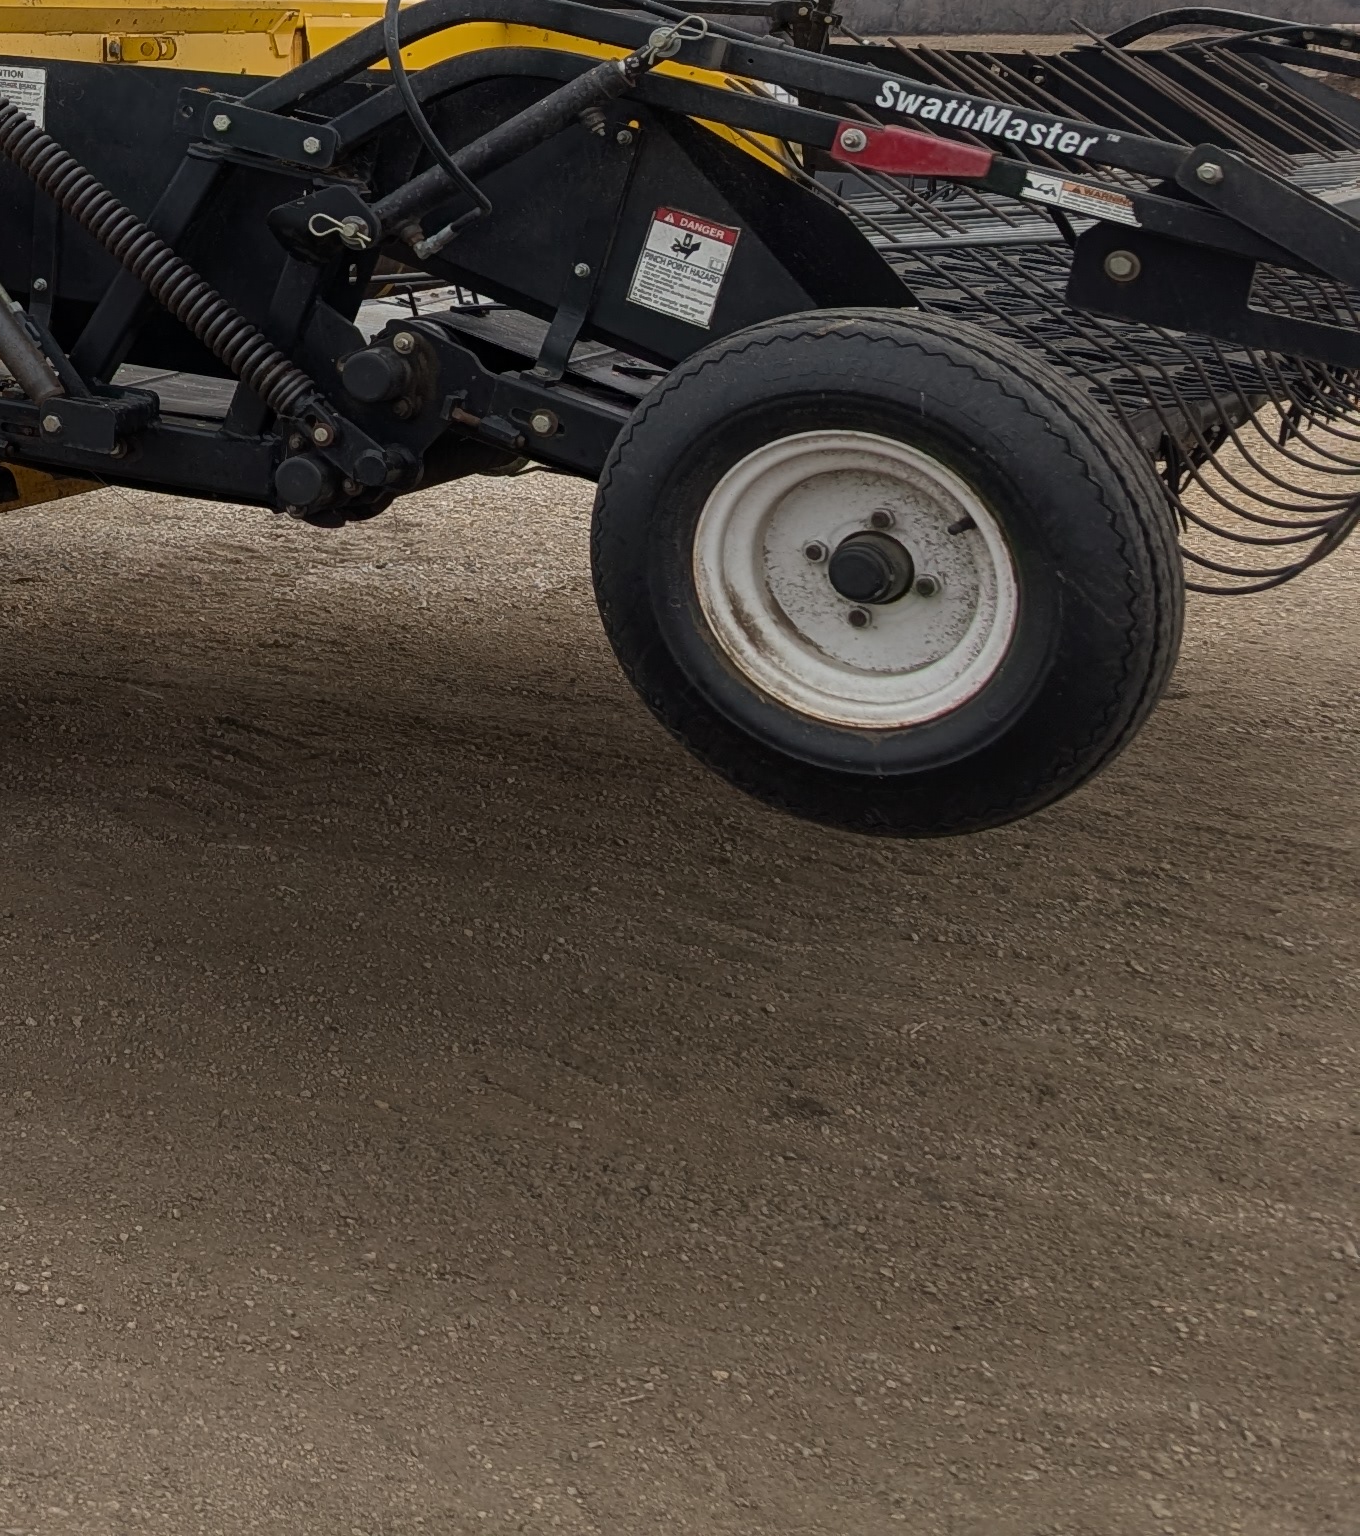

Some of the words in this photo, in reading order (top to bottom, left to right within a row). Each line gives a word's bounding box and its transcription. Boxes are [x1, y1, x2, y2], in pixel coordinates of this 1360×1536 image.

[679, 217, 725, 240] DANGER
[644, 252, 666, 264] PINCH
[667, 260, 690, 273] POINT
[690, 268, 720, 284] HAZARD
